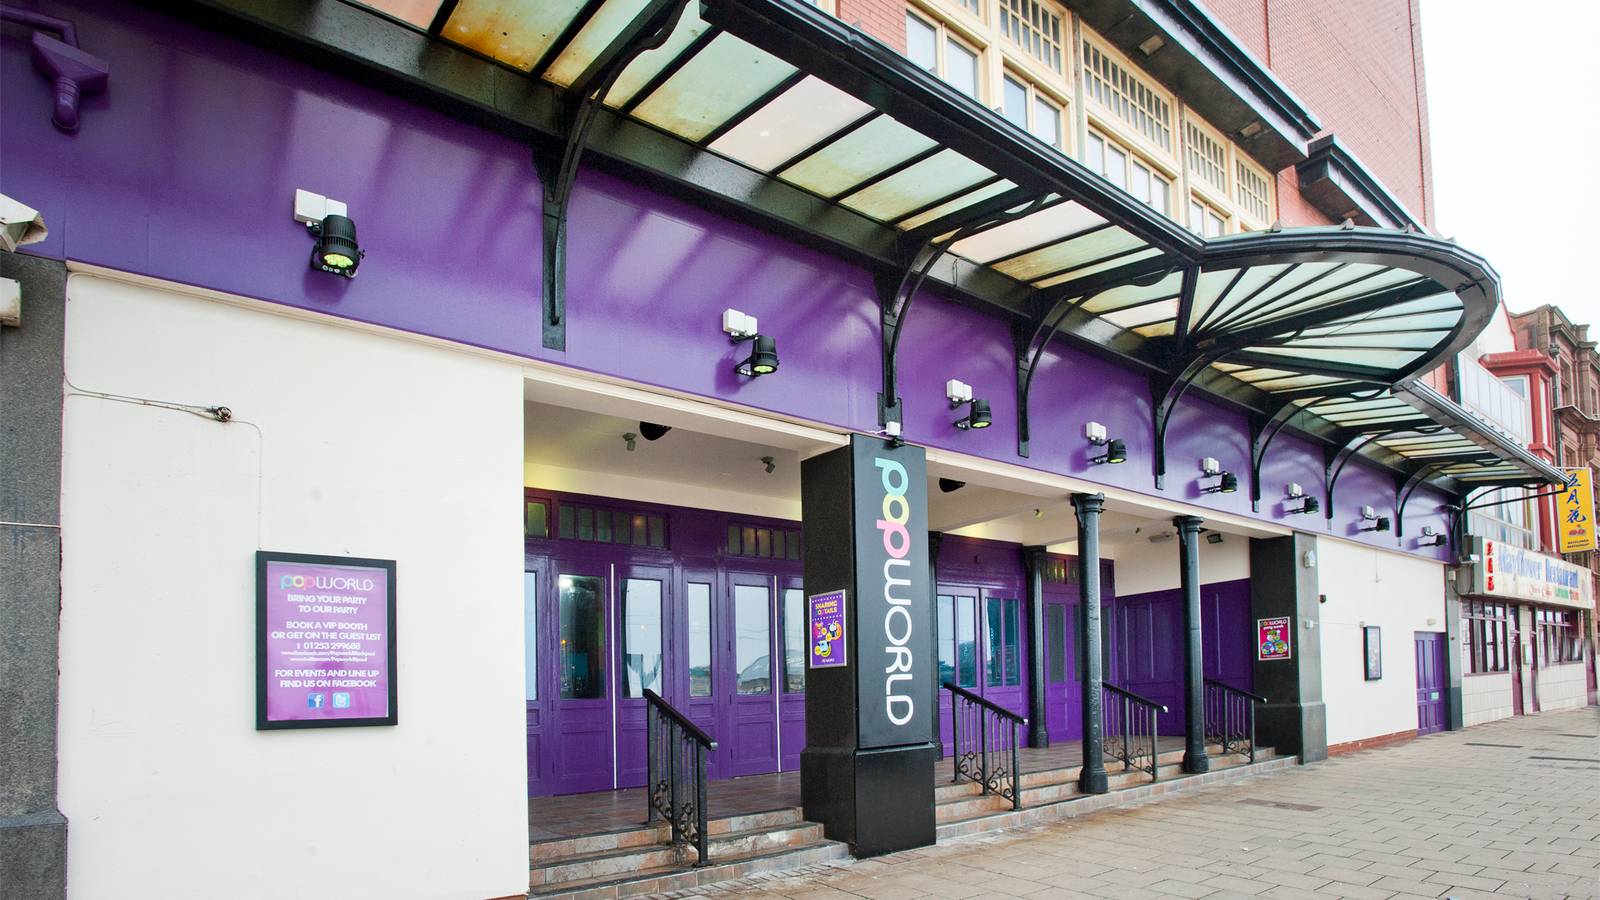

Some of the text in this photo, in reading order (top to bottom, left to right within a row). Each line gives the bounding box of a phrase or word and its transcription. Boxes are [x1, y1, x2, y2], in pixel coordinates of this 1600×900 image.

[287, 594, 368, 604] BRING YOUR PARTY
[298, 605, 359, 614] TO OUR PARTY
[286, 621, 314, 629] BOOK
[322, 622, 338, 630] VIP
[338, 622, 368, 630] BOOTH
[271, 631, 285, 639] OR
[321, 632, 338, 640] THE
[338, 632, 366, 641] GUEST
[366, 633, 382, 641] LIST
[303, 642, 330, 650] 01253
[275, 669, 294, 677] FOR
[294, 669, 327, 677] EVENTS
[327, 669, 347, 677] AND
[280, 680, 302, 688] FIND
